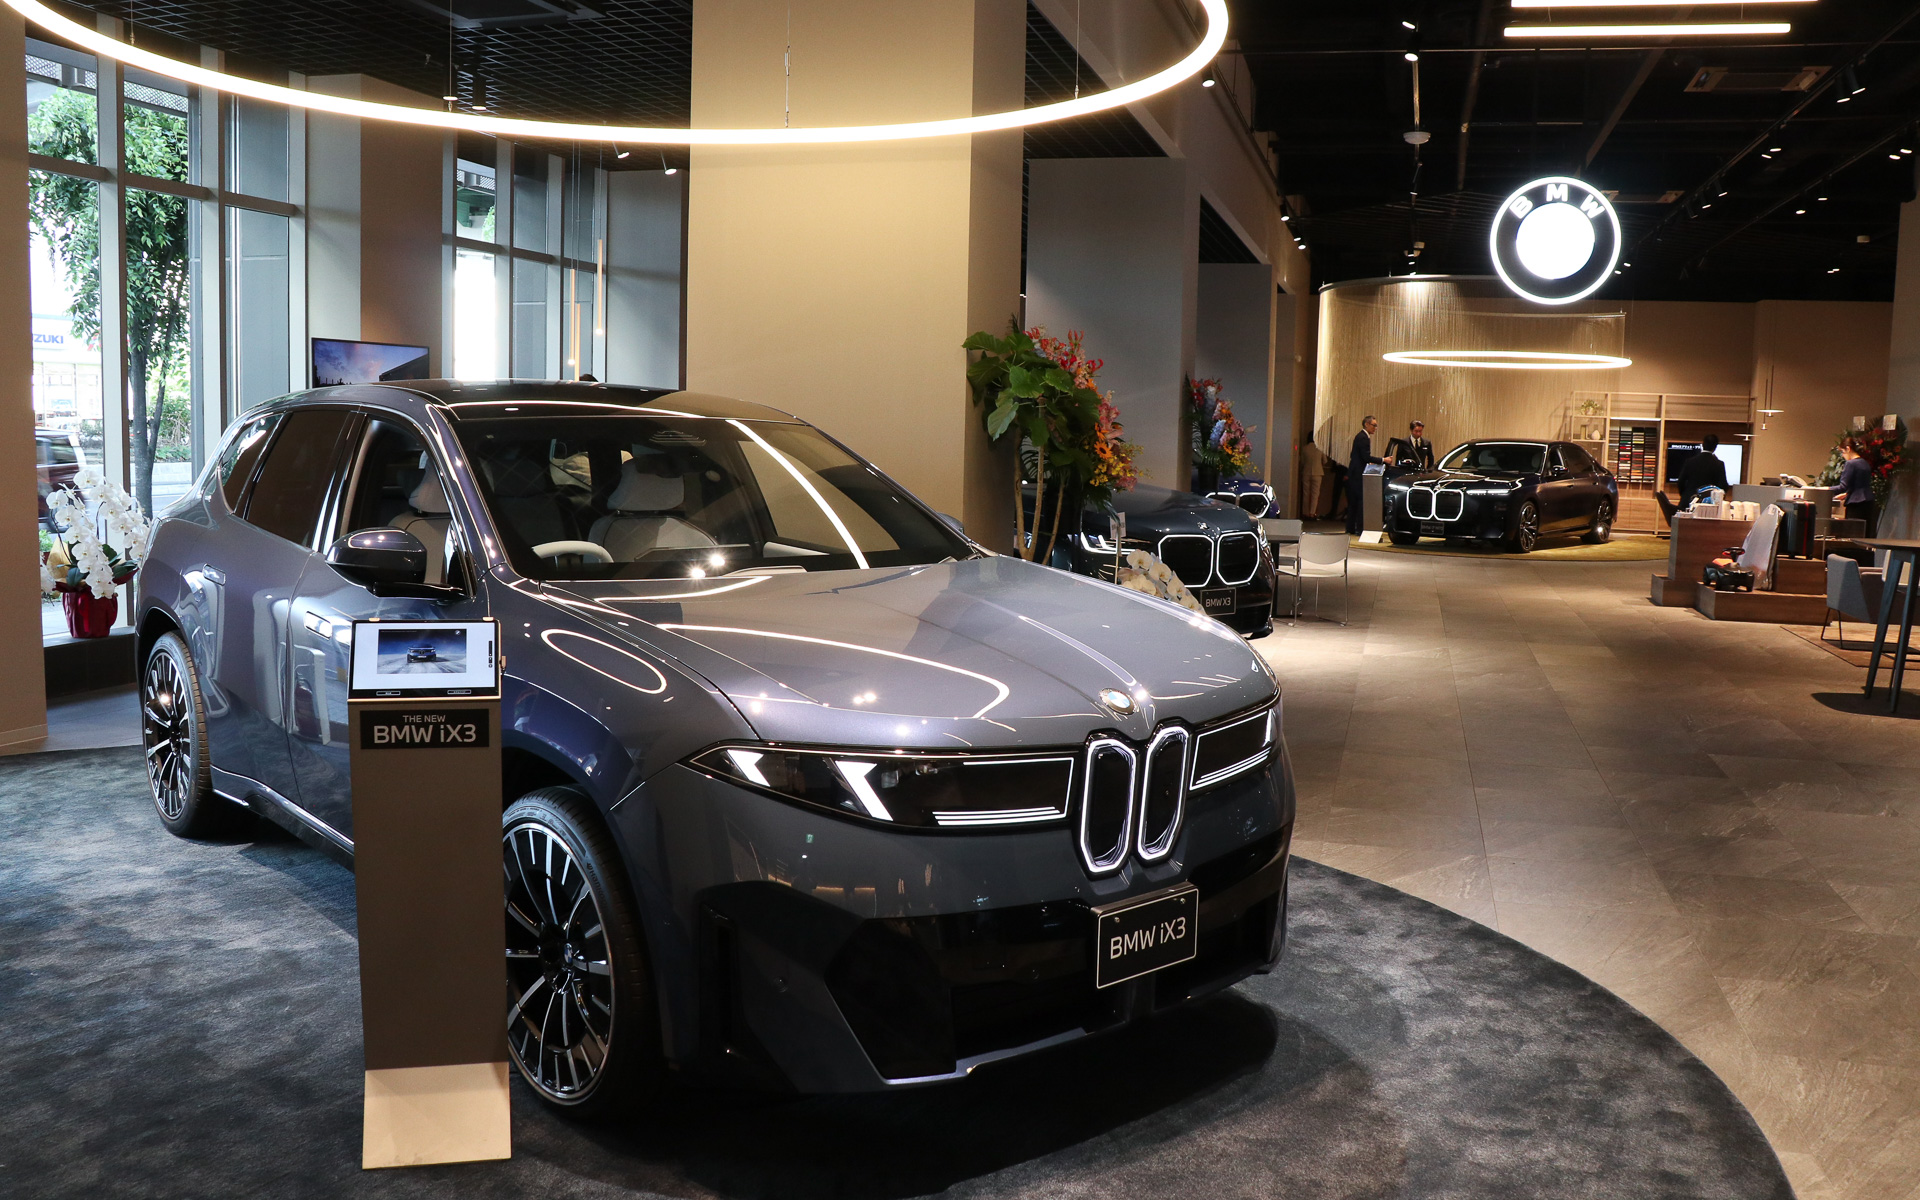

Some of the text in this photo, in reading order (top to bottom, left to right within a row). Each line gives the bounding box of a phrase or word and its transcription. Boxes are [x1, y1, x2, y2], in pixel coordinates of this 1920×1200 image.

[1508, 183, 1606, 220] BMW
[32, 334, 64, 344] ZUKI
[1205, 597, 1231, 607] BMW X3
[402, 714, 446, 723] THE NEW
[373, 724, 476, 744] BMW iX3
[1110, 916, 1186, 960] BMW iX3
